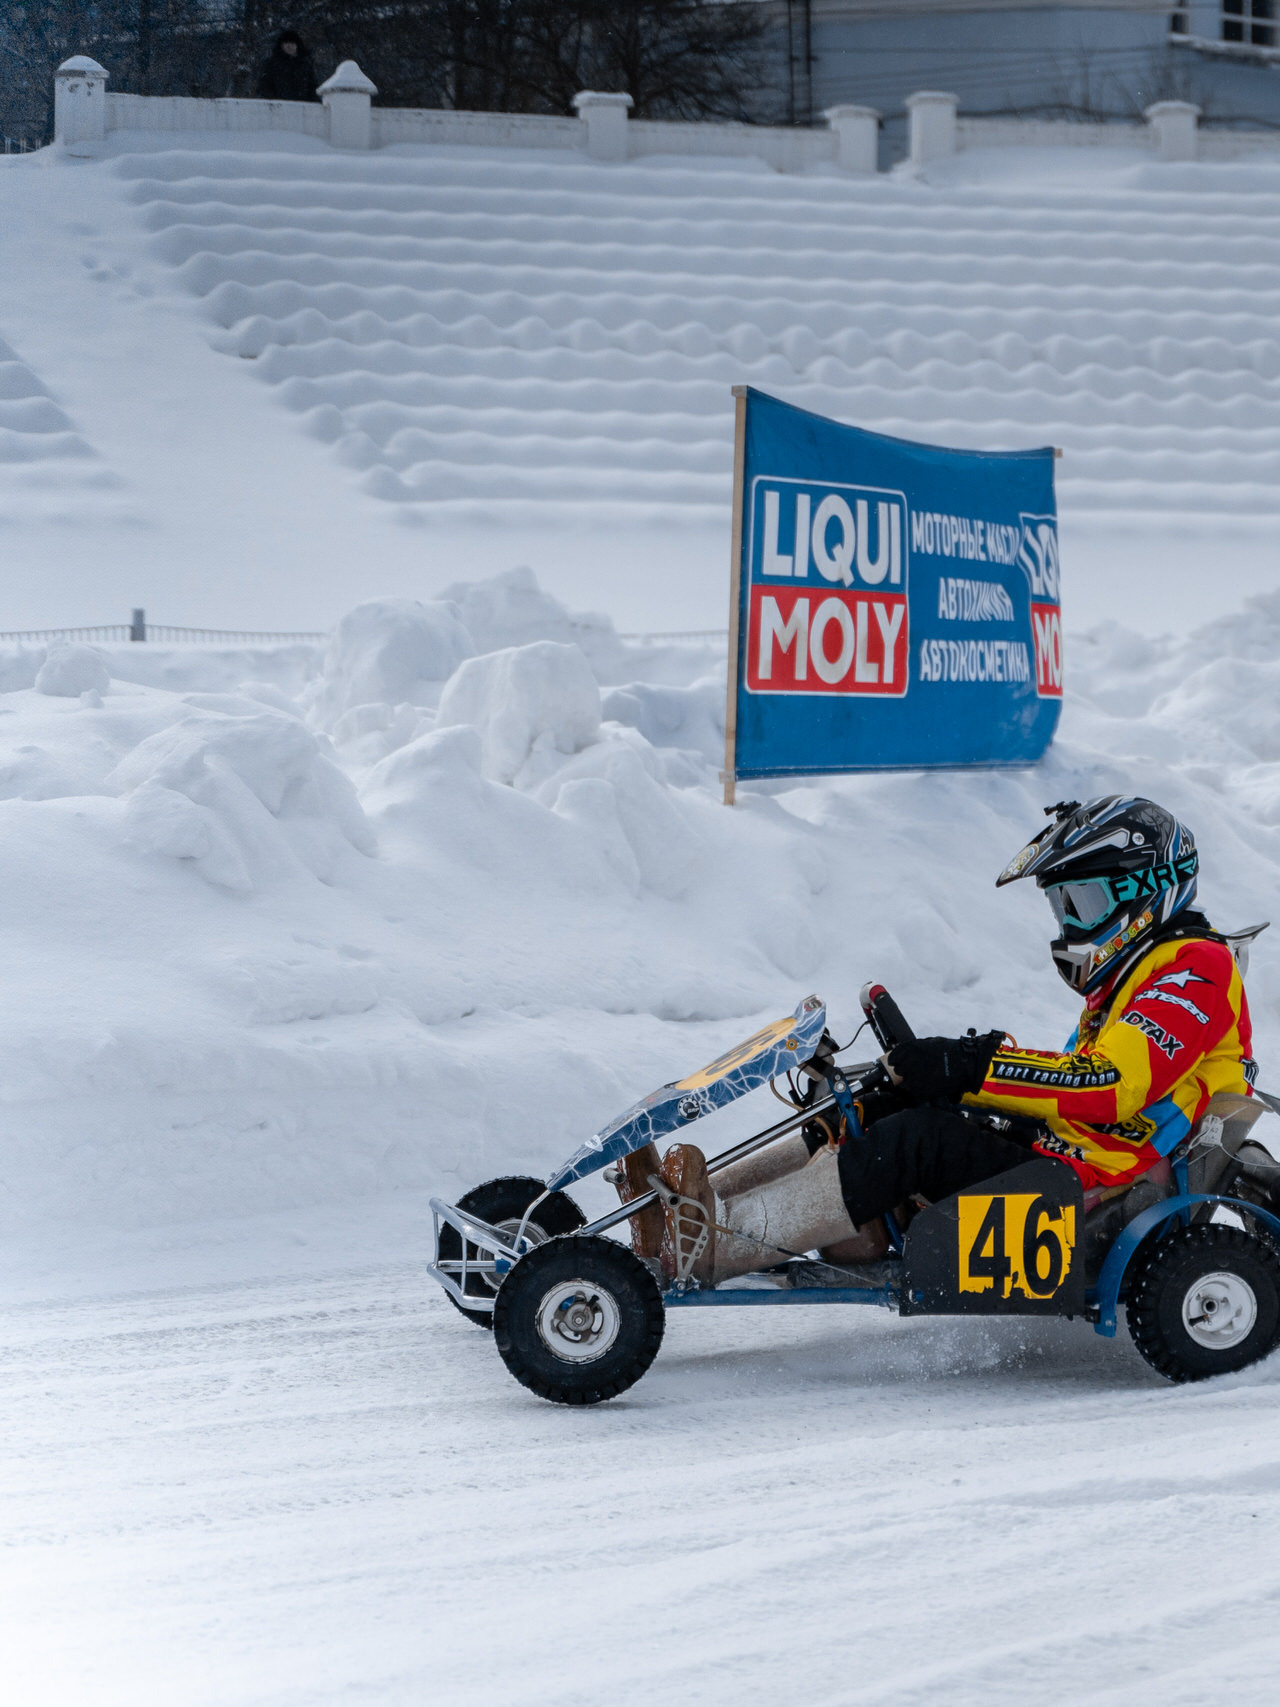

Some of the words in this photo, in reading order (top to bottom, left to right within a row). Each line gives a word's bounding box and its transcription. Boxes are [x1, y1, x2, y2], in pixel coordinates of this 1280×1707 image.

[762, 490, 901, 588] LIQUI
[912, 510, 987, 562] МОТОРНЫЕ
[986, 521, 1020, 566] МАСЛ
[938, 577, 1015, 622] АВТОХИМИЯ
[757, 595, 906, 684] MOLY
[920, 638, 1031, 682] АВТОКОСМЕТИКА
[1108, 863, 1176, 903] FXR
[1093, 942, 1116, 966] THE
[1112, 911, 1154, 951] DOCTOR
[996, 1063, 1030, 1079] kart
[1032, 1069, 1081, 1087] racing
[1084, 1070, 1115, 1086] team
[968, 1196, 1063, 1297] 46
